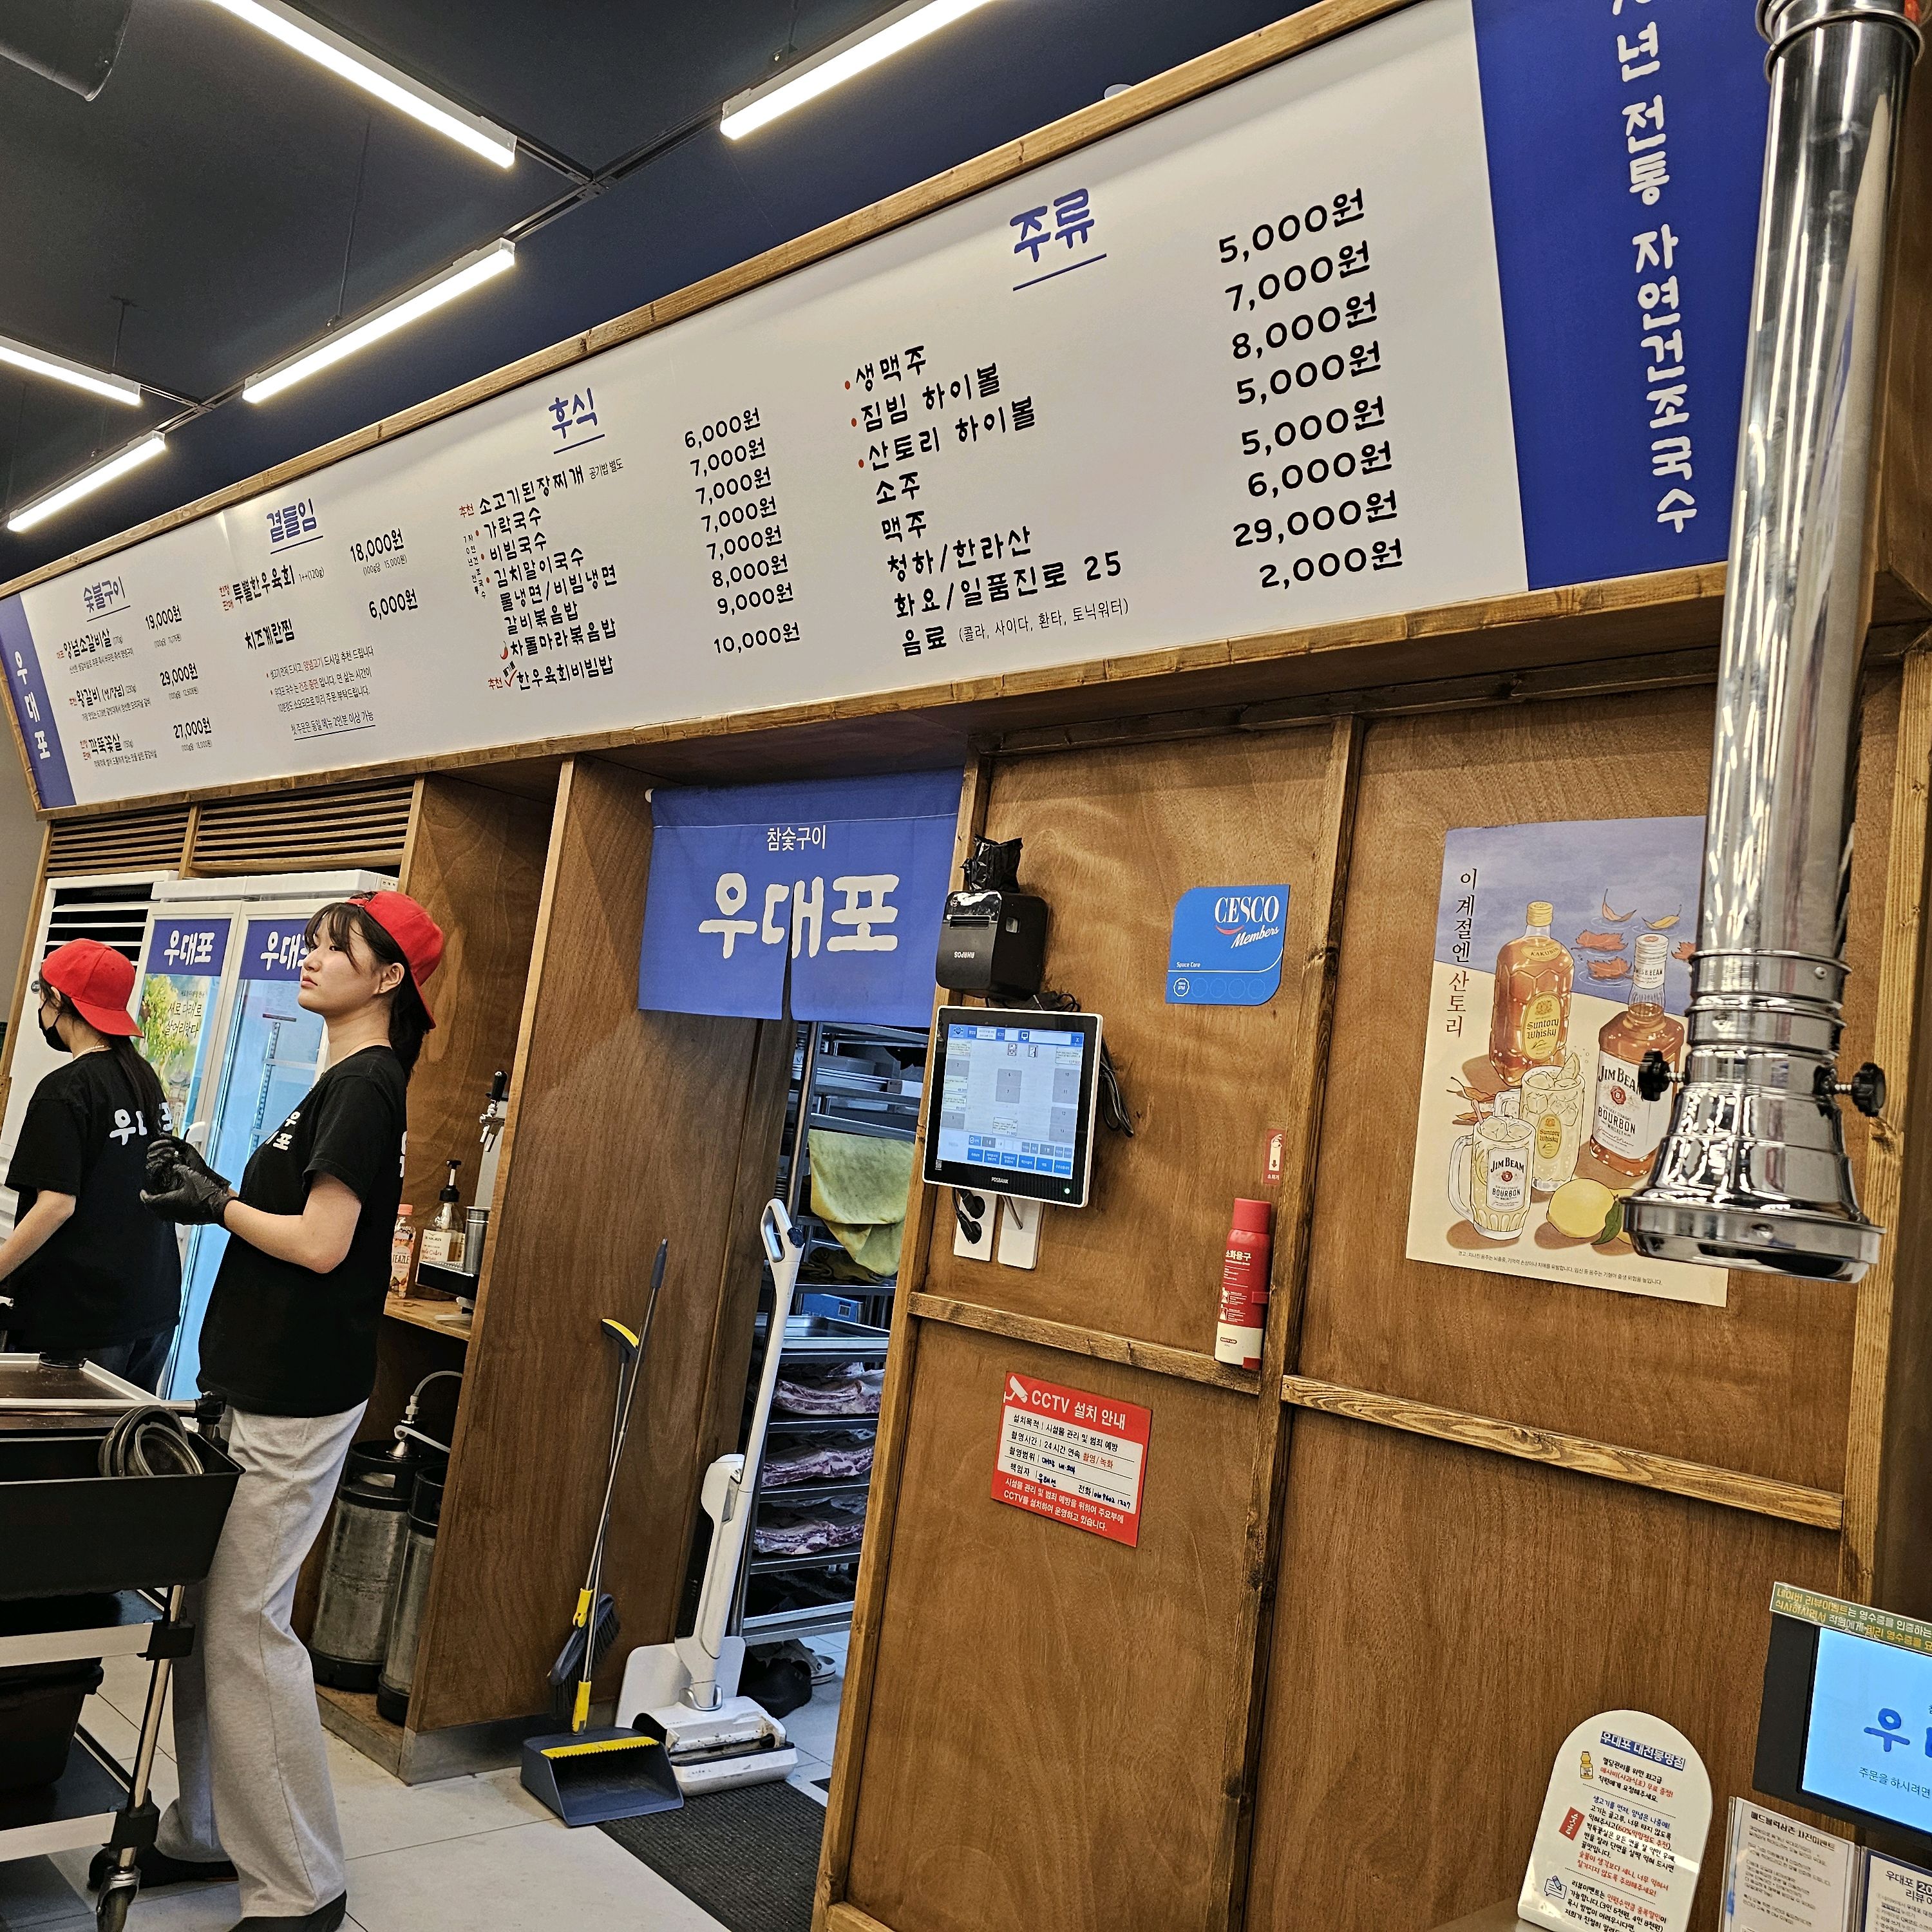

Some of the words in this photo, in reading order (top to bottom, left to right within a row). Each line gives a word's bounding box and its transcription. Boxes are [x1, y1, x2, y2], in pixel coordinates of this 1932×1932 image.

[1622, 94, 1670, 206] 전통
[1009, 186, 1095, 265] 주류
[1218, 187, 1366, 264] 5,000원
[1224, 239, 1372, 313] 7,000원
[1231, 291, 1379, 361] 8,000원
[855, 345, 927, 392] 생맥주
[1236, 340, 1383, 406] 5,000원
[1633, 223, 1697, 534] 자연건조국수
[548, 387, 598, 439] 후식
[860, 394, 909, 433] 짐빔
[922, 362, 1002, 412] 하이볼
[684, 407, 761, 449] 6,000원
[867, 426, 940, 471] 산토리
[954, 395, 1036, 444] 하이볼
[1240, 395, 1387, 458] 5,000원
[689, 437, 766, 478] 7,000원
[1246, 440, 1394, 499] 6,000원
[459, 503, 475, 518] 추천
[479, 464, 585, 516] 소고기된장찌개
[589, 463, 609, 480] 공기밥
[609, 457, 624, 474] 별도
[695, 466, 772, 506] 7,000원
[875, 471, 922, 505] 소주
[266, 498, 317, 543] 곁들임
[484, 506, 542, 539] 가락국수
[700, 496, 778, 533] 7,000원
[881, 510, 929, 545] 맥주
[1232, 489, 1399, 549] 29,000원
[350, 528, 404, 563] 18,000원
[489, 531, 547, 562] 비빔국수
[706, 524, 783, 562] 7,000원
[887, 526, 1033, 583] 청하/한라산
[363, 562, 381, 576] (100g당
[384, 554, 407, 569] 15,000원)
[493, 547, 585, 589] 김치말이국수
[711, 553, 789, 589] 8,000원
[1258, 537, 1404, 590] 2,000원
[84, 576, 126, 612] 숯불구이
[233, 564, 296, 604] 투뿔한우육회
[500, 564, 618, 612] 물냉면/비빔냉면
[717, 582, 795, 616] 9,000원
[894, 561, 1069, 620] 화요/일품진로
[1084, 551, 1122, 583] 25
[145, 605, 182, 631] 19,000원
[369, 588, 418, 620] 6,000원
[504, 600, 579, 636] 갈비볶음밥
[64, 628, 112, 659] 양념소갈비살
[245, 618, 294, 650] 치즈계란찜
[510, 618, 616, 658] 차돌마라볶음밥
[713, 622, 800, 655] 10,000원
[901, 625, 947, 657] 음료
[959, 623, 989, 643] (콜라,
[995, 615, 1033, 636] 사이다,
[1038, 609, 1066, 629] 환타,
[1073, 598, 1128, 622] 토닉워터)
[324, 653, 340, 667] 드시길
[341, 650, 352, 663] 추천
[353, 645, 374, 659] 드립니다
[355, 666, 372, 680] 시간이
[488, 676, 504, 690] 추천
[516, 654, 614, 691] 한우육회비빔밥
[160, 662, 198, 687] 29,000원
[337, 685, 370, 699] 부탁드립니다.
[15, 651, 50, 760] 우대포
[77, 686, 101, 708] 왕갈비
[173, 717, 211, 740] 27,000원
[333, 714, 348, 727] 2인분
[348, 712, 361, 724] 이상
[361, 710, 374, 722] 가능
[766, 824, 827, 851] 참숯구이
[1460, 867, 1479, 890] 이
[699, 872, 900, 959] 우대포
[1215, 896, 1279, 923] CESCO
[1231, 925, 1280, 949] Members
[1452, 895, 1476, 964] 계절엔
[164, 930, 215, 966] 우대포
[1530, 947, 1559, 956] KAKUBIN
[1649, 968, 1663, 976] BEAM
[168, 1000, 180, 1021] 서로
[1445, 969, 1468, 1038] 산토리
[1527, 1018, 1559, 1030] Suntory
[1527, 1028, 1557, 1039] Whisky
[1598, 1065, 1615, 1083] JIM
[285, 1105, 300, 1126] 우
[1598, 1106, 1636, 1134] BOURBON
[1491, 1159, 1504, 1172] JIM
[1505, 1157, 1524, 1173] BEAM
[1492, 1188, 1520, 1197] BOURBON
[392, 1255, 410, 1264] TEAZLE
[1226, 1249, 1252, 1261] 소화용구
[1032, 1390, 1070, 1413] CCTV
[1074, 1401, 1097, 1422] 설치
[1102, 1409, 1126, 1430] 안내
[1011, 1431, 1037, 1446] 촬영시간
[1068, 1447, 1081, 1459] 연속
[1083, 1452, 1113, 1468] 촬영/녹화
[1014, 1414, 1039, 1429] 설치목적
[1046, 1423, 1065, 1436] 시설물
[1067, 1430, 1079, 1441] 관리
[1082, 1434, 1088, 1443] 및
[1090, 1437, 1103, 1448] 범죄
[1105, 1441, 1118, 1452] 예방
[1009, 1446, 1035, 1463] 촬영범위
[1010, 1463, 1030, 1476] 책임자
[1078, 1485, 1091, 1496] 전화
[1004, 1490, 1028, 1505] CCTV를
[1030, 1499, 1053, 1513] 설치하여
[1054, 1506, 1079, 1521] 운영하고
[1081, 1515, 1107, 1531] 있습니다.
[1025, 1484, 1036, 1495] 관리
[1079, 1501, 1097, 1514] 위하여
[1099, 1508, 1124, 1524] 주요부에
[1805, 1595, 1857, 1618] 리뷰이벤트는
[1859, 1610, 1893, 1626] 영수증을
[1896, 1620, 1931, 1638] 인증하는
[1886, 1630, 1921, 1648] 영수증을
[1602, 1732, 1631, 1750] 우대포
[1633, 1744, 1685, 1770] 대전봉명점
[1645, 1772, 1663, 1784] 최고급
[1660, 1788, 1674, 1797] 증정!
[1859, 1766, 1888, 1785] 주문을
[1890, 1777, 1931, 1799] 하시려면
[1590, 1805, 1607, 1816] 고기는
[1609, 1810, 1625, 1824] 골고루,
[1627, 1819, 1638, 1828] 너무
[1654, 1828, 1671, 1840] 않도록
[1593, 1795, 1615, 1809] 생고기를
[1632, 1810, 1649, 1821] 양념은
[1650, 1817, 1670, 1829] 나중에!
[1582, 1841, 1611, 1858] 꿀맛입니다.
[1597, 1857, 1620, 1871] 생각보다
[1602, 1870, 1618, 1882] 않도록
[1886, 1870, 1914, 1888] 우대포
[1571, 1880, 1605, 1899] 리뷰이벤트는
[1607, 1893, 1635, 1911] 인원수만큼
[1906, 1889, 1925, 1904] 리뷰
